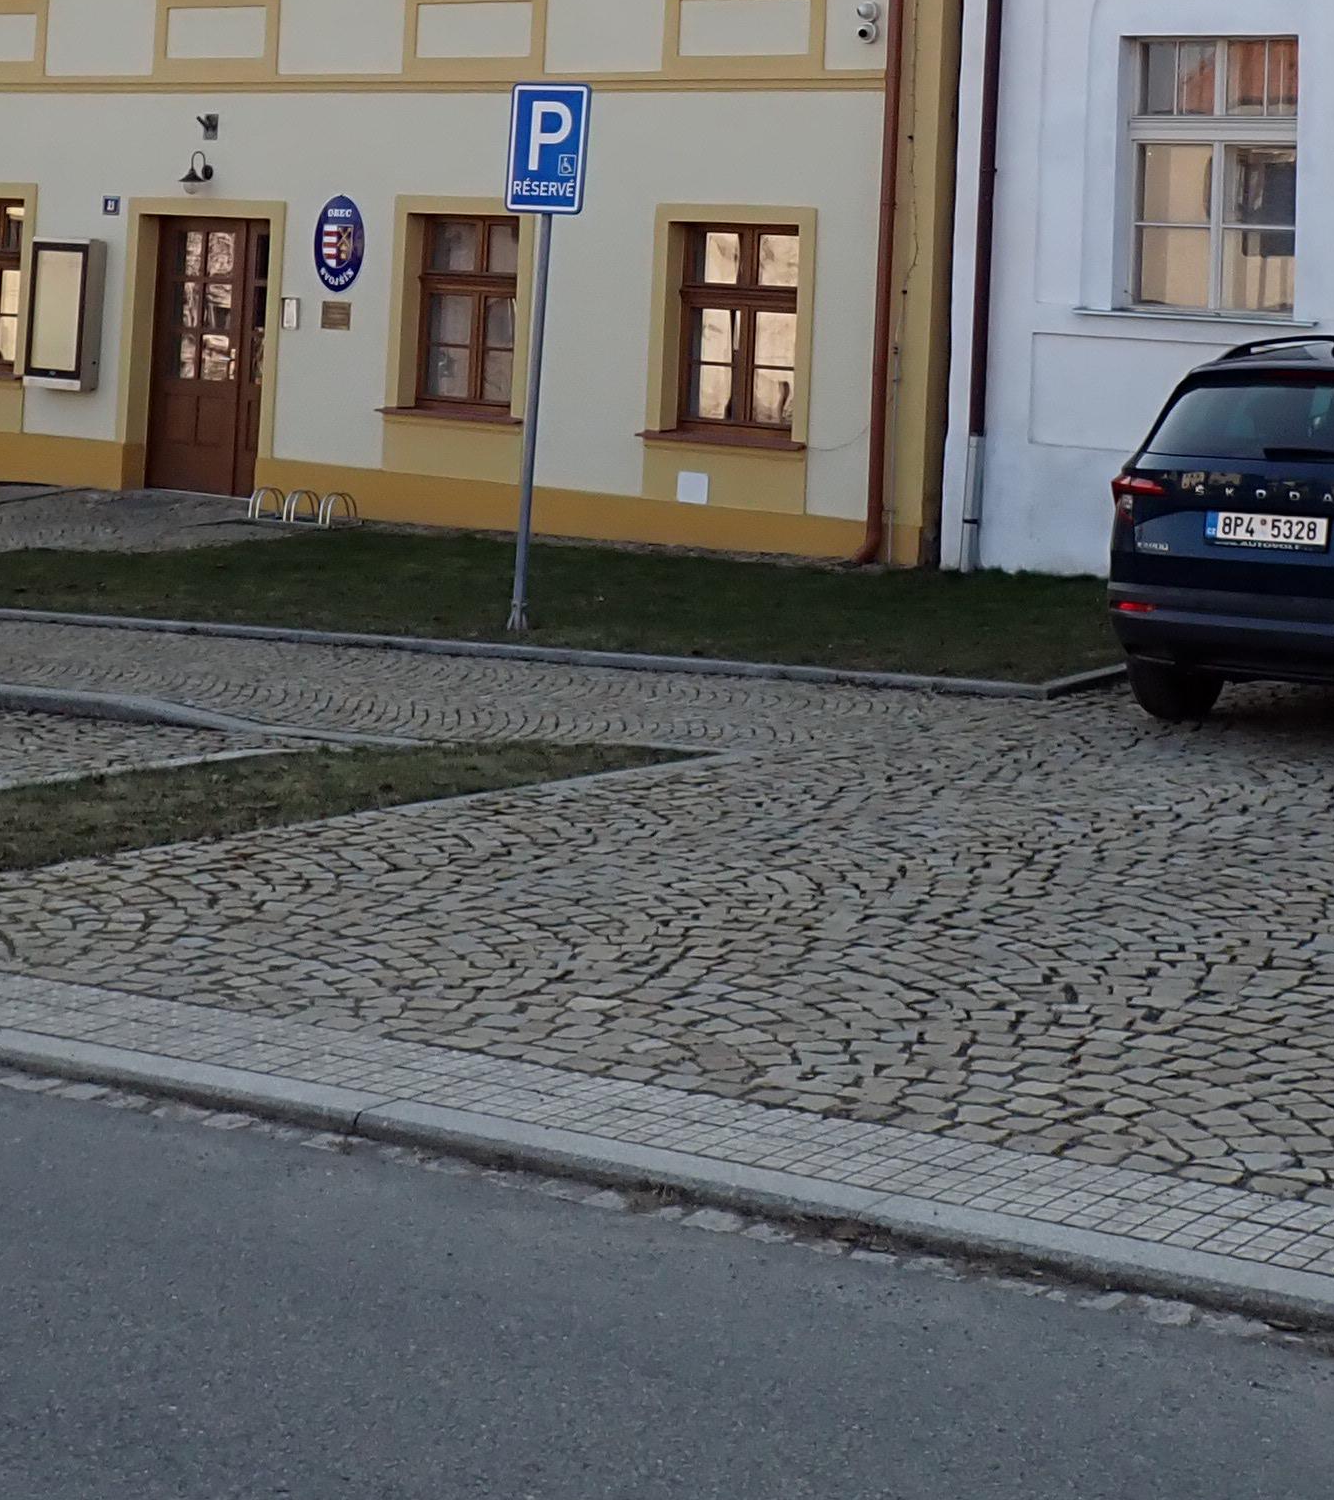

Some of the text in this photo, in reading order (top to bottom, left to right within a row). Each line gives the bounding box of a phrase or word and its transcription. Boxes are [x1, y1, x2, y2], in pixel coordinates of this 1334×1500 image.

[528, 100, 573, 171] P
[513, 178, 576, 197] RÉSERVÉ
[327, 207, 353, 218] OBEC
[1221, 516, 1318, 541] 8P4 5328
